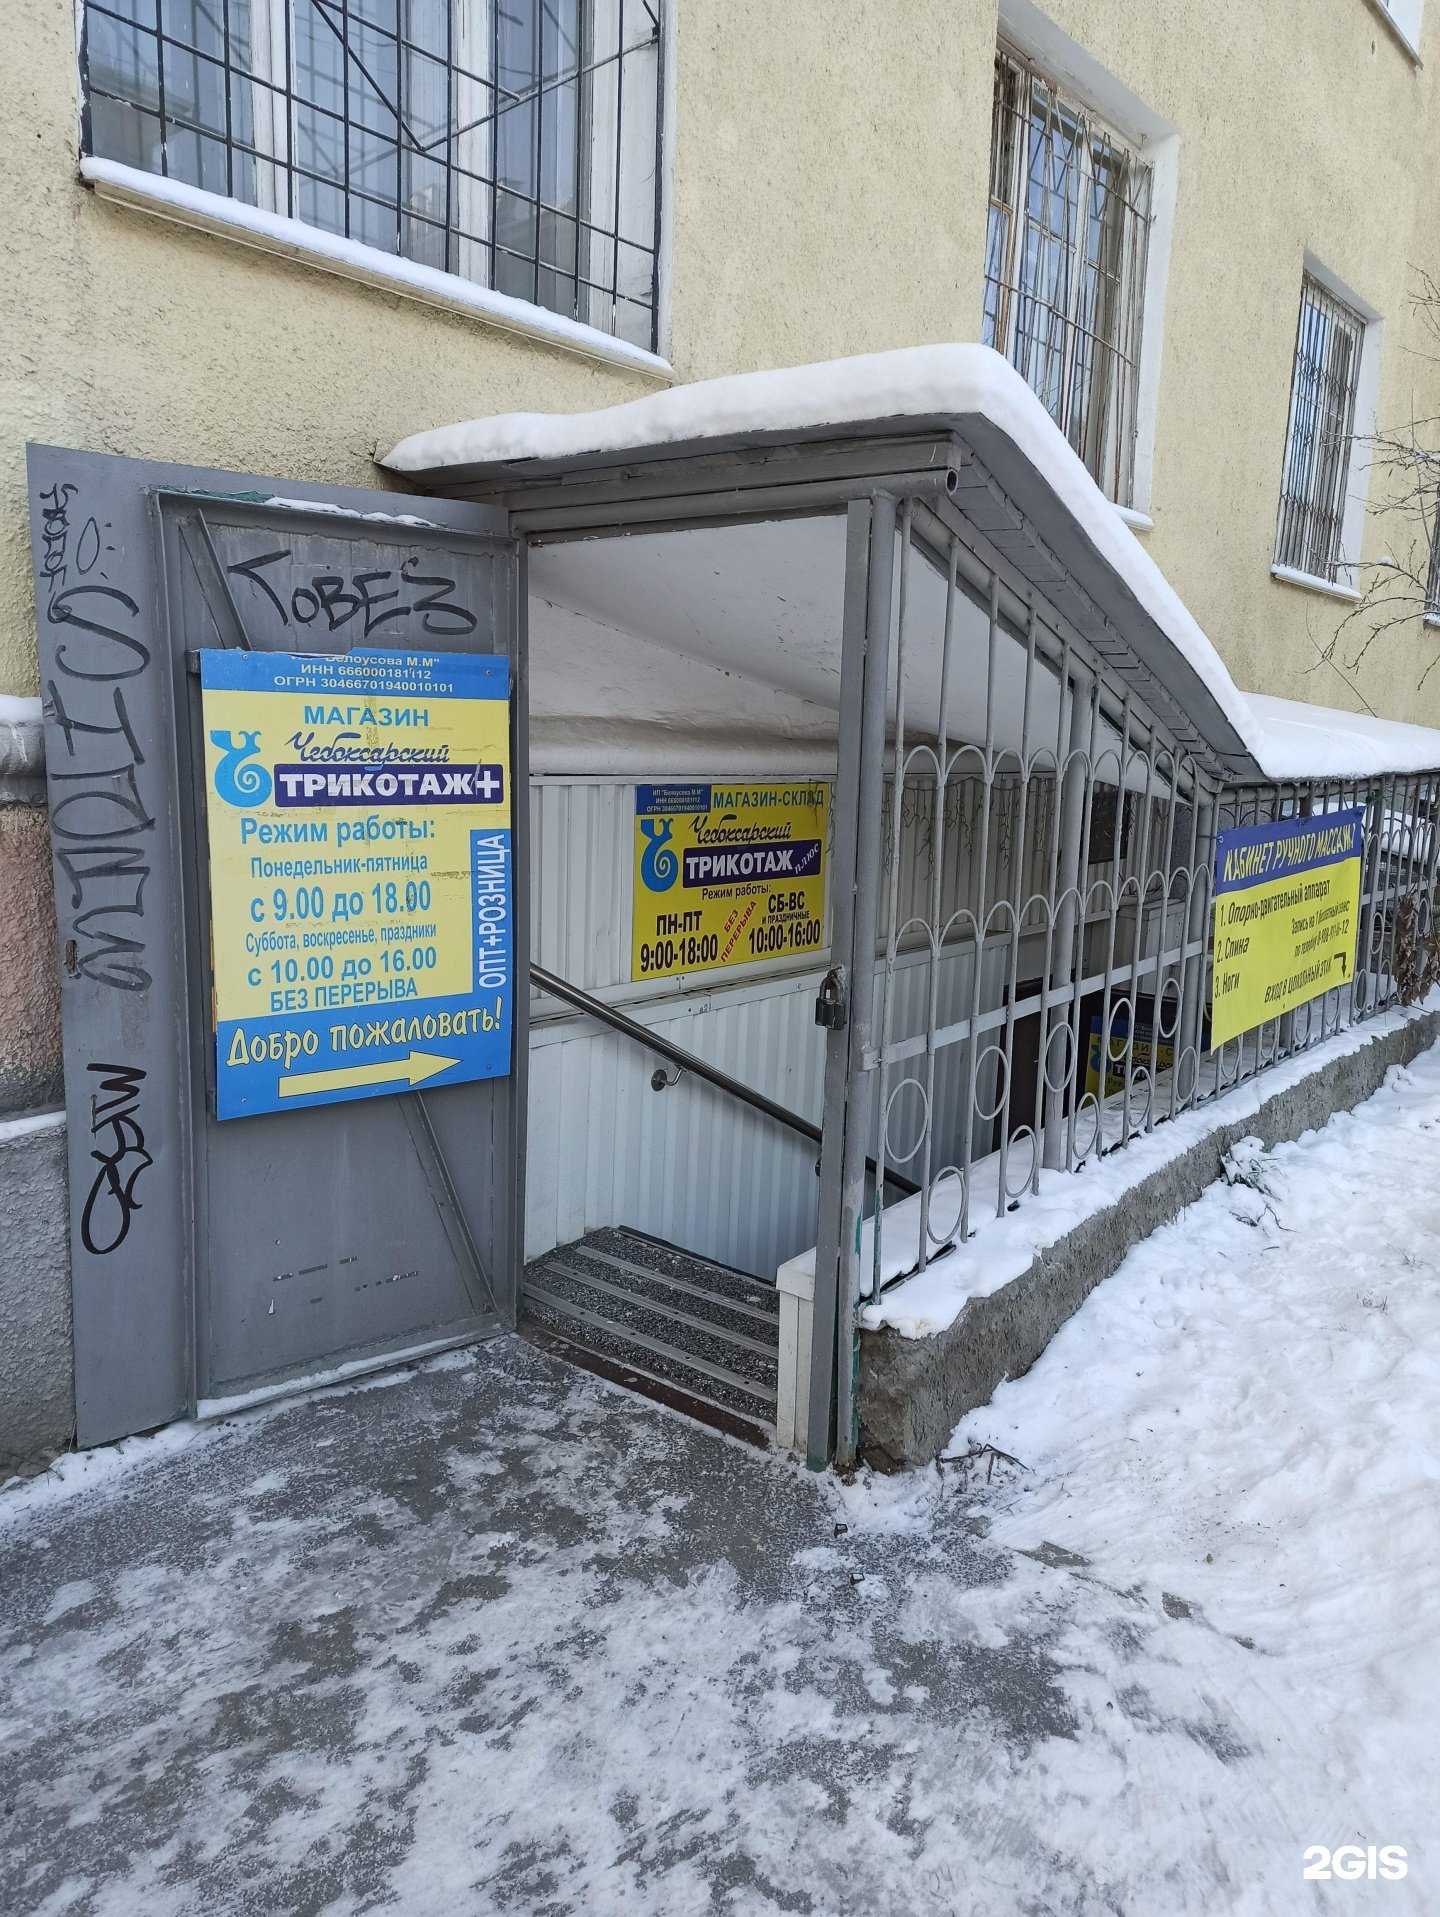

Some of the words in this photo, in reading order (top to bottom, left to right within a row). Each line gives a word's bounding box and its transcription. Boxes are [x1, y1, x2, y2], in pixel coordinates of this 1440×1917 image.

[274, 676, 316, 688] ОГРН
[301, 664, 334, 675] ИНН
[304, 705, 429, 727] МАГАЗИН
[285, 731, 450, 763] Чебоксарский
[713, 790, 824, 808] МАГАЗИН-СКЛАД
[240, 817, 328, 845] Режим
[337, 815, 436, 847] работы:
[689, 814, 793, 844] Чебоксарский
[250, 854, 428, 879] Понедельник-пятница
[686, 850, 794, 880] ТРИКОТАЖ
[1223, 841, 1274, 882] КАБИНЕТ
[1272, 832, 1316, 870] РУЧНОГО
[251, 897, 265, 922] с
[273, 886, 325, 921] 9.00
[332, 891, 364, 922] до
[372, 880, 432, 914] 18.00
[702, 888, 733, 900] Режим
[768, 891, 805, 913] СБ-ВС
[1304, 880, 1331, 901] аппарат
[656, 911, 702, 936] ПН-ПТ
[720, 900, 758, 963] ПЕРЕРЫВА
[724, 909, 739, 933] БЕЗ
[246, 932, 299, 957] Суббота,
[303, 926, 378, 950] воскресенье,
[380, 921, 436, 944] праздники
[749, 919, 820, 954] 10:00-16:00
[1225, 937, 1250, 960] Спина
[248, 967, 262, 987] с
[271, 955, 333, 984] 10.00
[341, 958, 372, 981] до
[380, 946, 437, 973] 16.00
[641, 934, 718, 972] 9:00-18:00
[271, 989, 308, 1012] БЕЗ
[315, 977, 418, 1008] ПЕРЕРЫВА
[1222, 972, 1240, 995] Ноги
[226, 1027, 319, 1070] Добро
[330, 995, 503, 1052] пожаловать!
